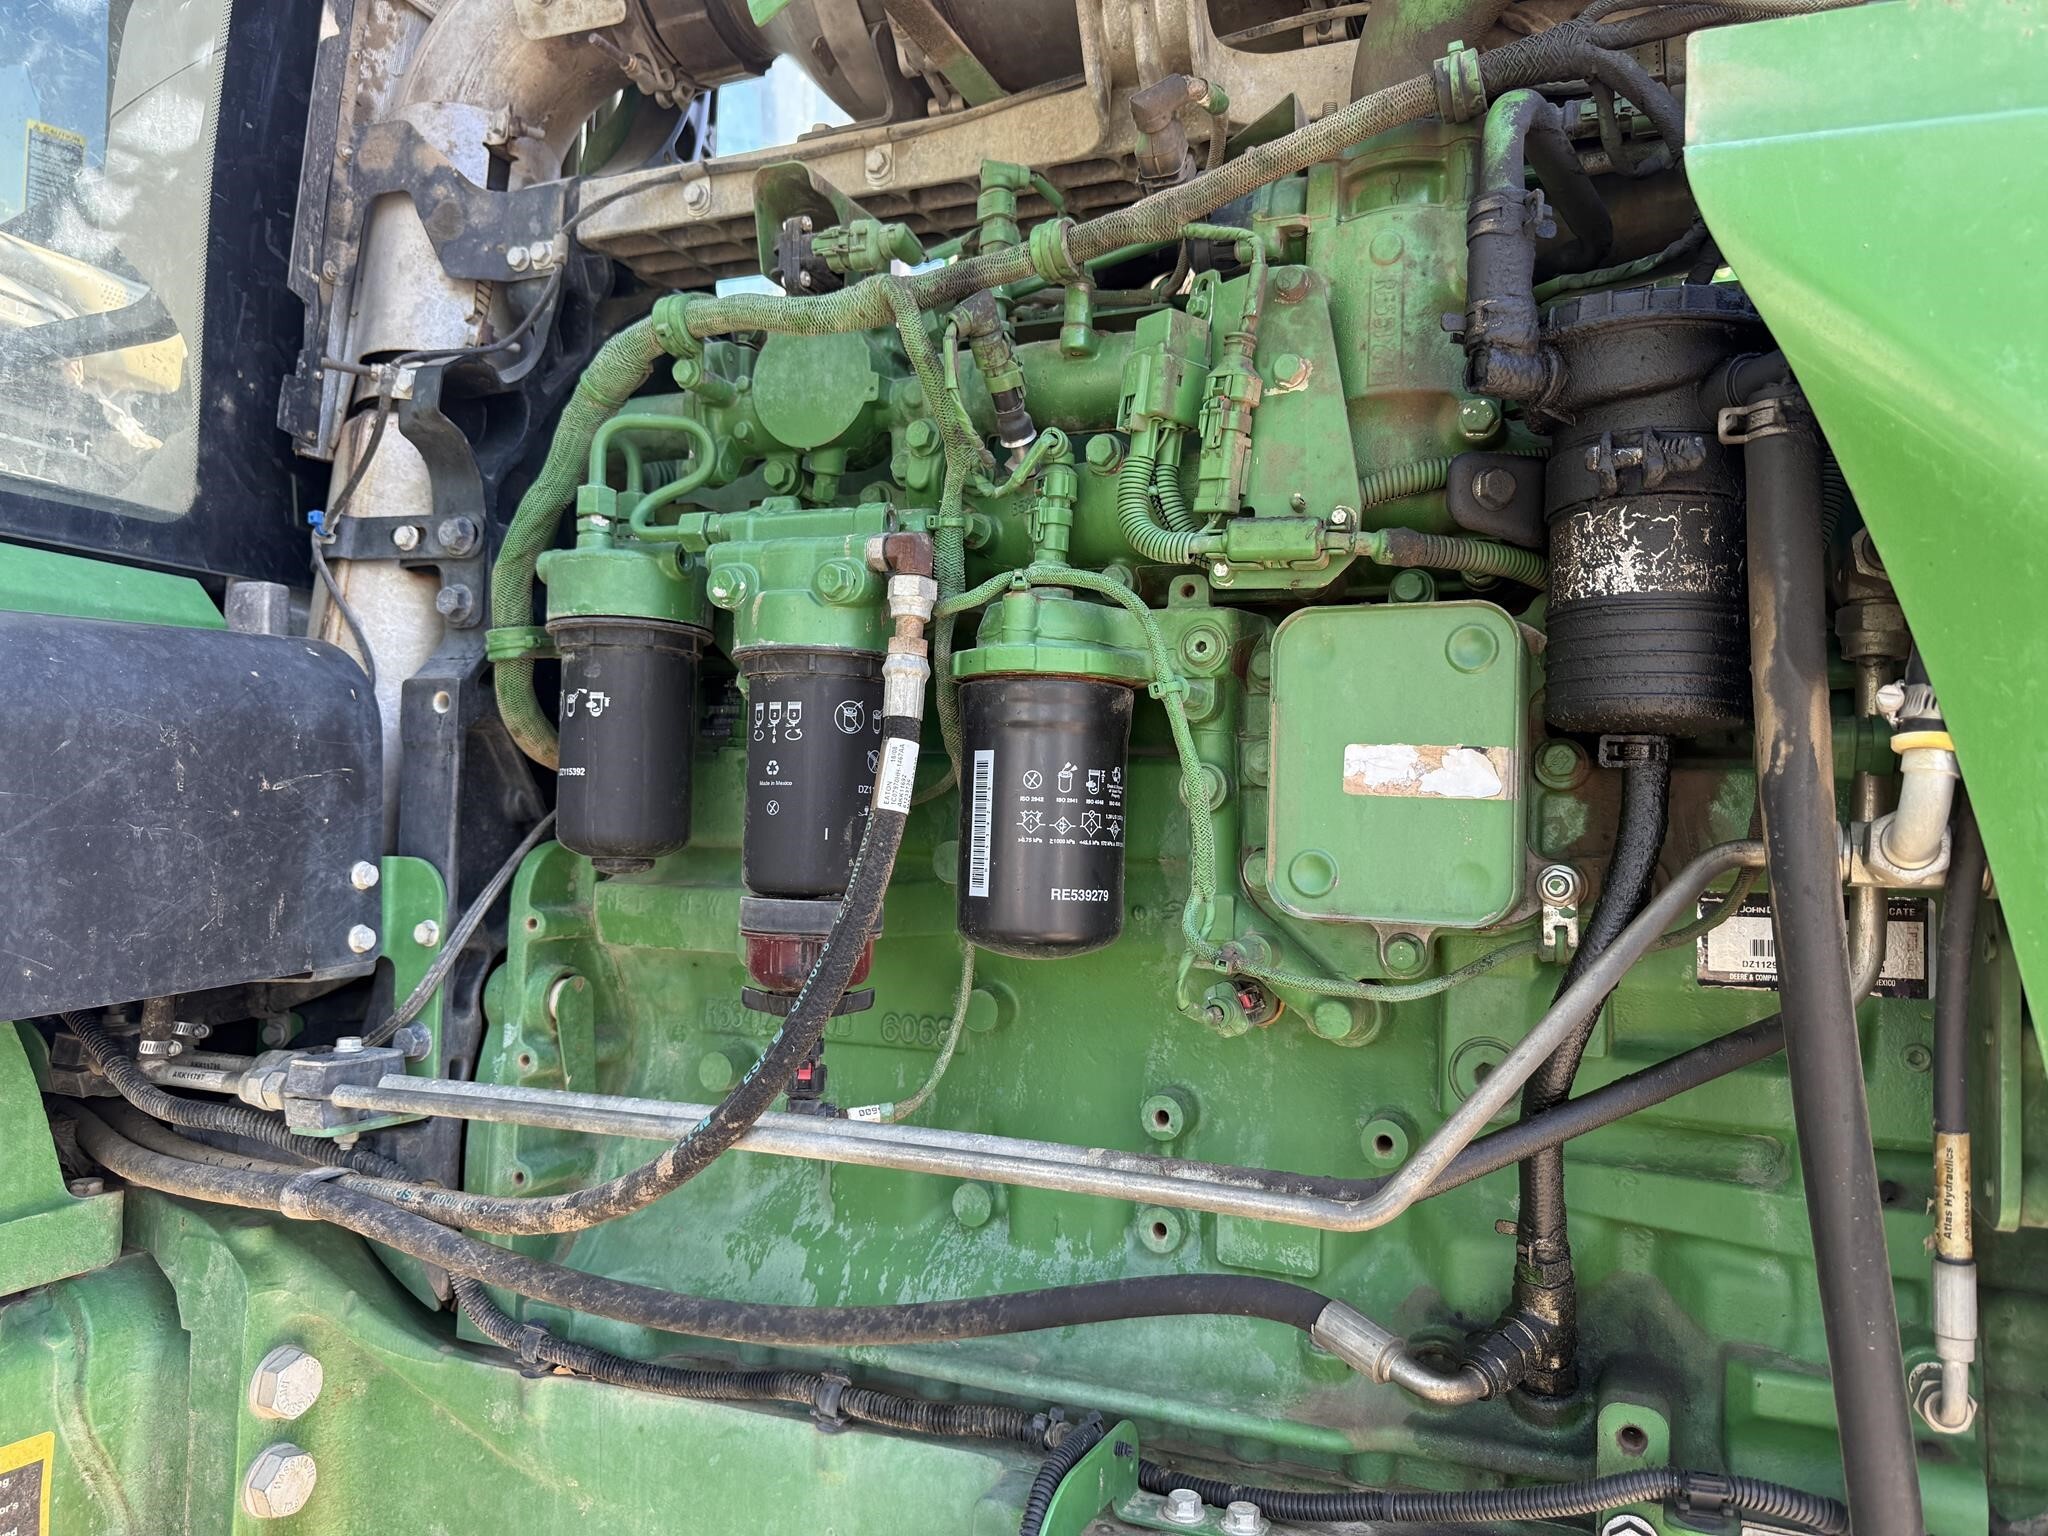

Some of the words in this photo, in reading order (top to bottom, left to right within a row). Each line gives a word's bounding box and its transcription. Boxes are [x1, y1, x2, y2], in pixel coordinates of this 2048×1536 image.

[883, 780, 893, 805] EATON
[1050, 887, 1109, 902] RE539279
[1740, 905, 1766, 914] JOHN
[1729, 972, 1749, 981] DEERE
[880, 1010, 951, 1047] 6068
[1943, 1146, 1956, 1208] Hydraulics
[1943, 1209, 1953, 1241] Atlas
